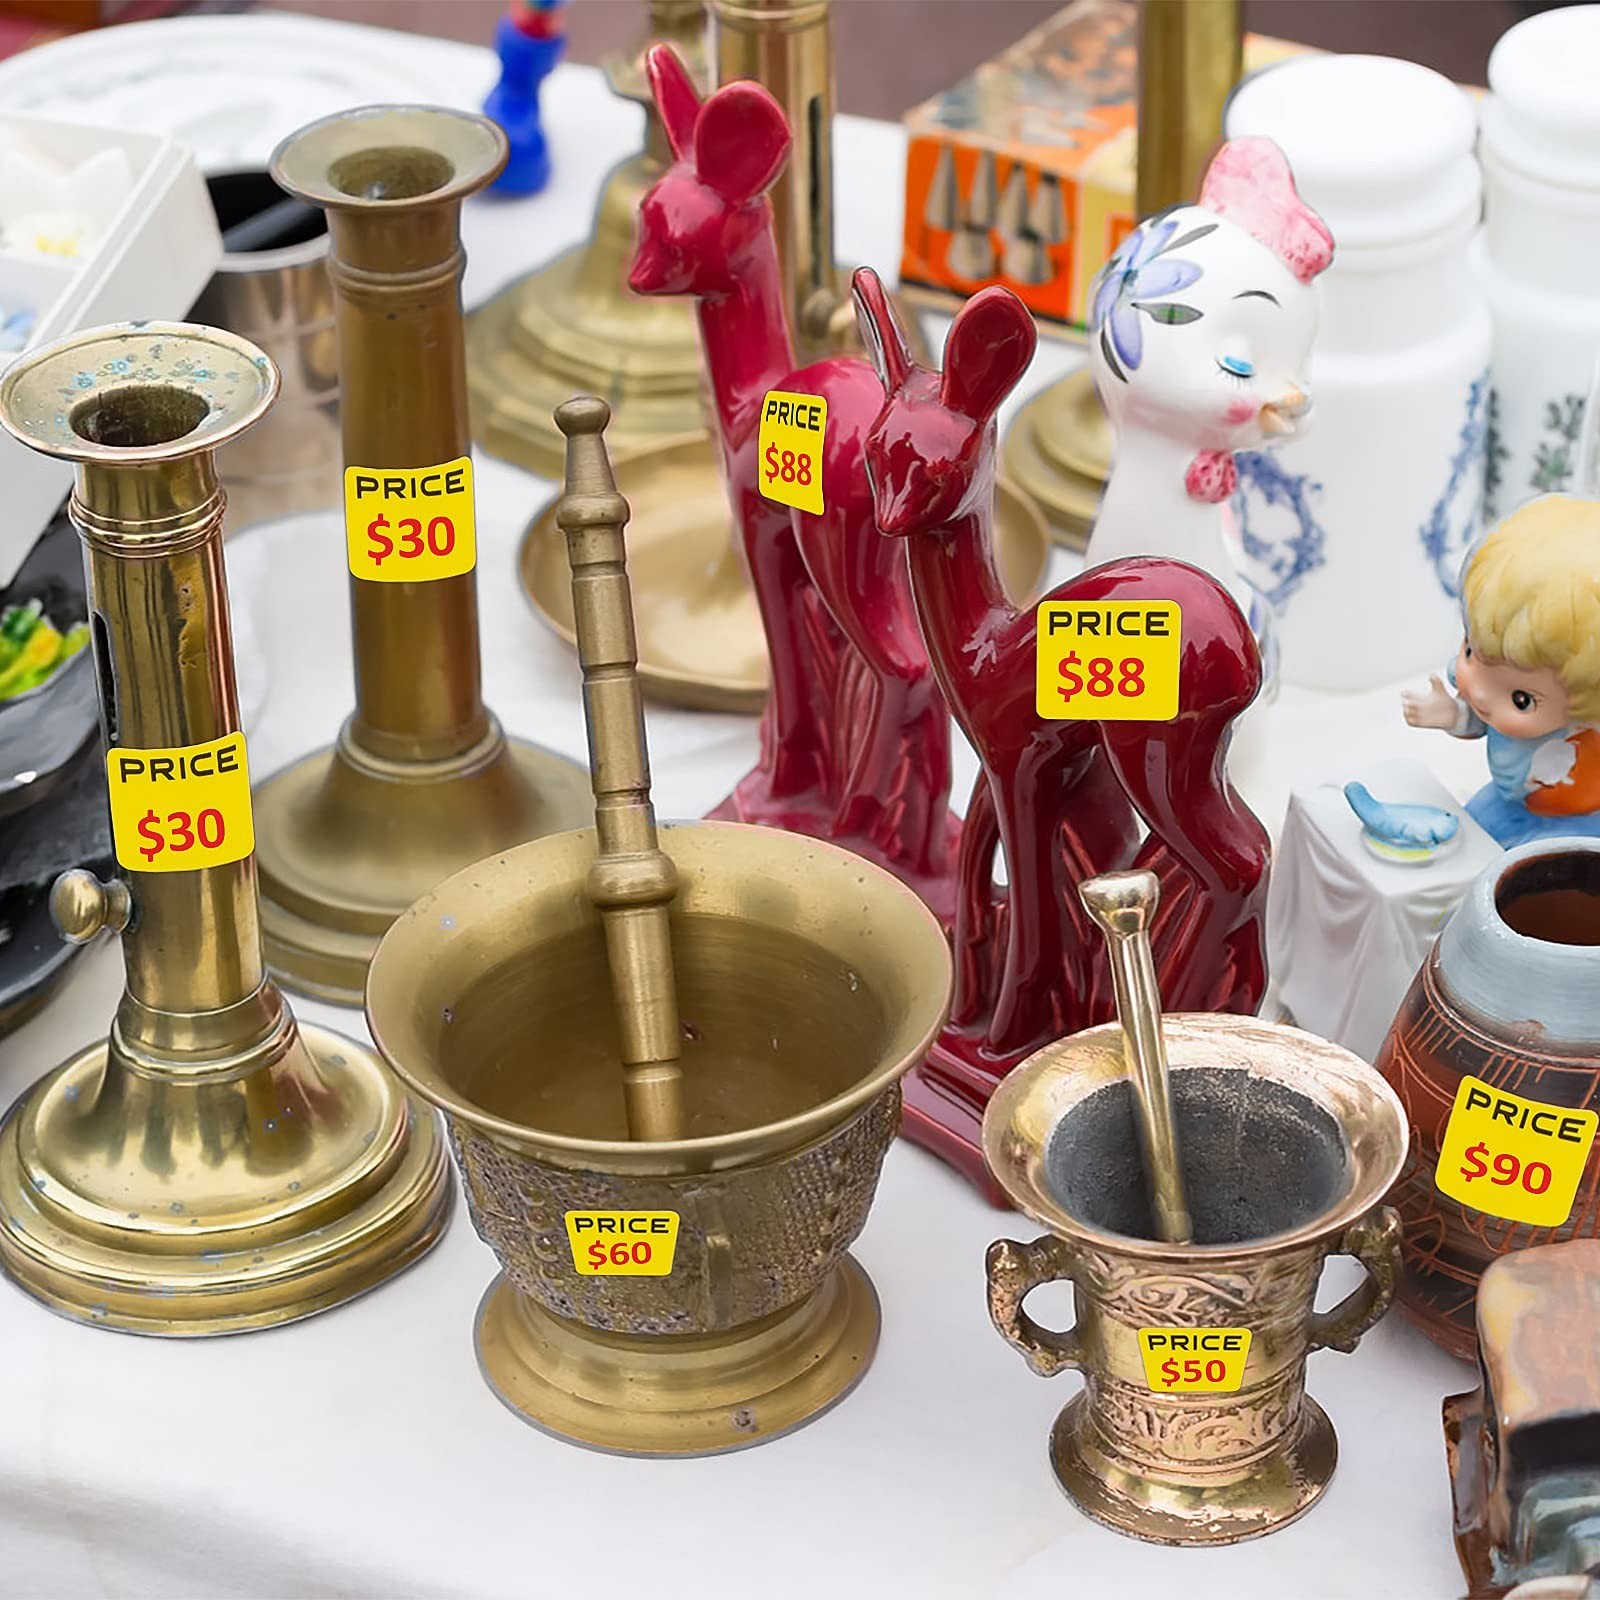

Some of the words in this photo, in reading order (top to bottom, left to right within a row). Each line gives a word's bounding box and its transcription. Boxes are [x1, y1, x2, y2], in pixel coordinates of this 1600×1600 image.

[764, 399, 822, 432] PRICE
[764, 441, 813, 487] $88
[355, 467, 465, 500] PRICE
[366, 513, 457, 566] $30
[1049, 610, 1171, 637] PRICE
[1056, 650, 1147, 703] $88
[119, 744, 240, 783] PRICE
[136, 807, 227, 863] $30
[1465, 1086, 1588, 1143] PRICE
[1459, 1140, 1553, 1196] $90
[574, 1217, 671, 1235] PRICE
[587, 1239, 653, 1271] $60
[1147, 1334, 1244, 1351] PRICE
[1160, 1357, 1227, 1388] $50
